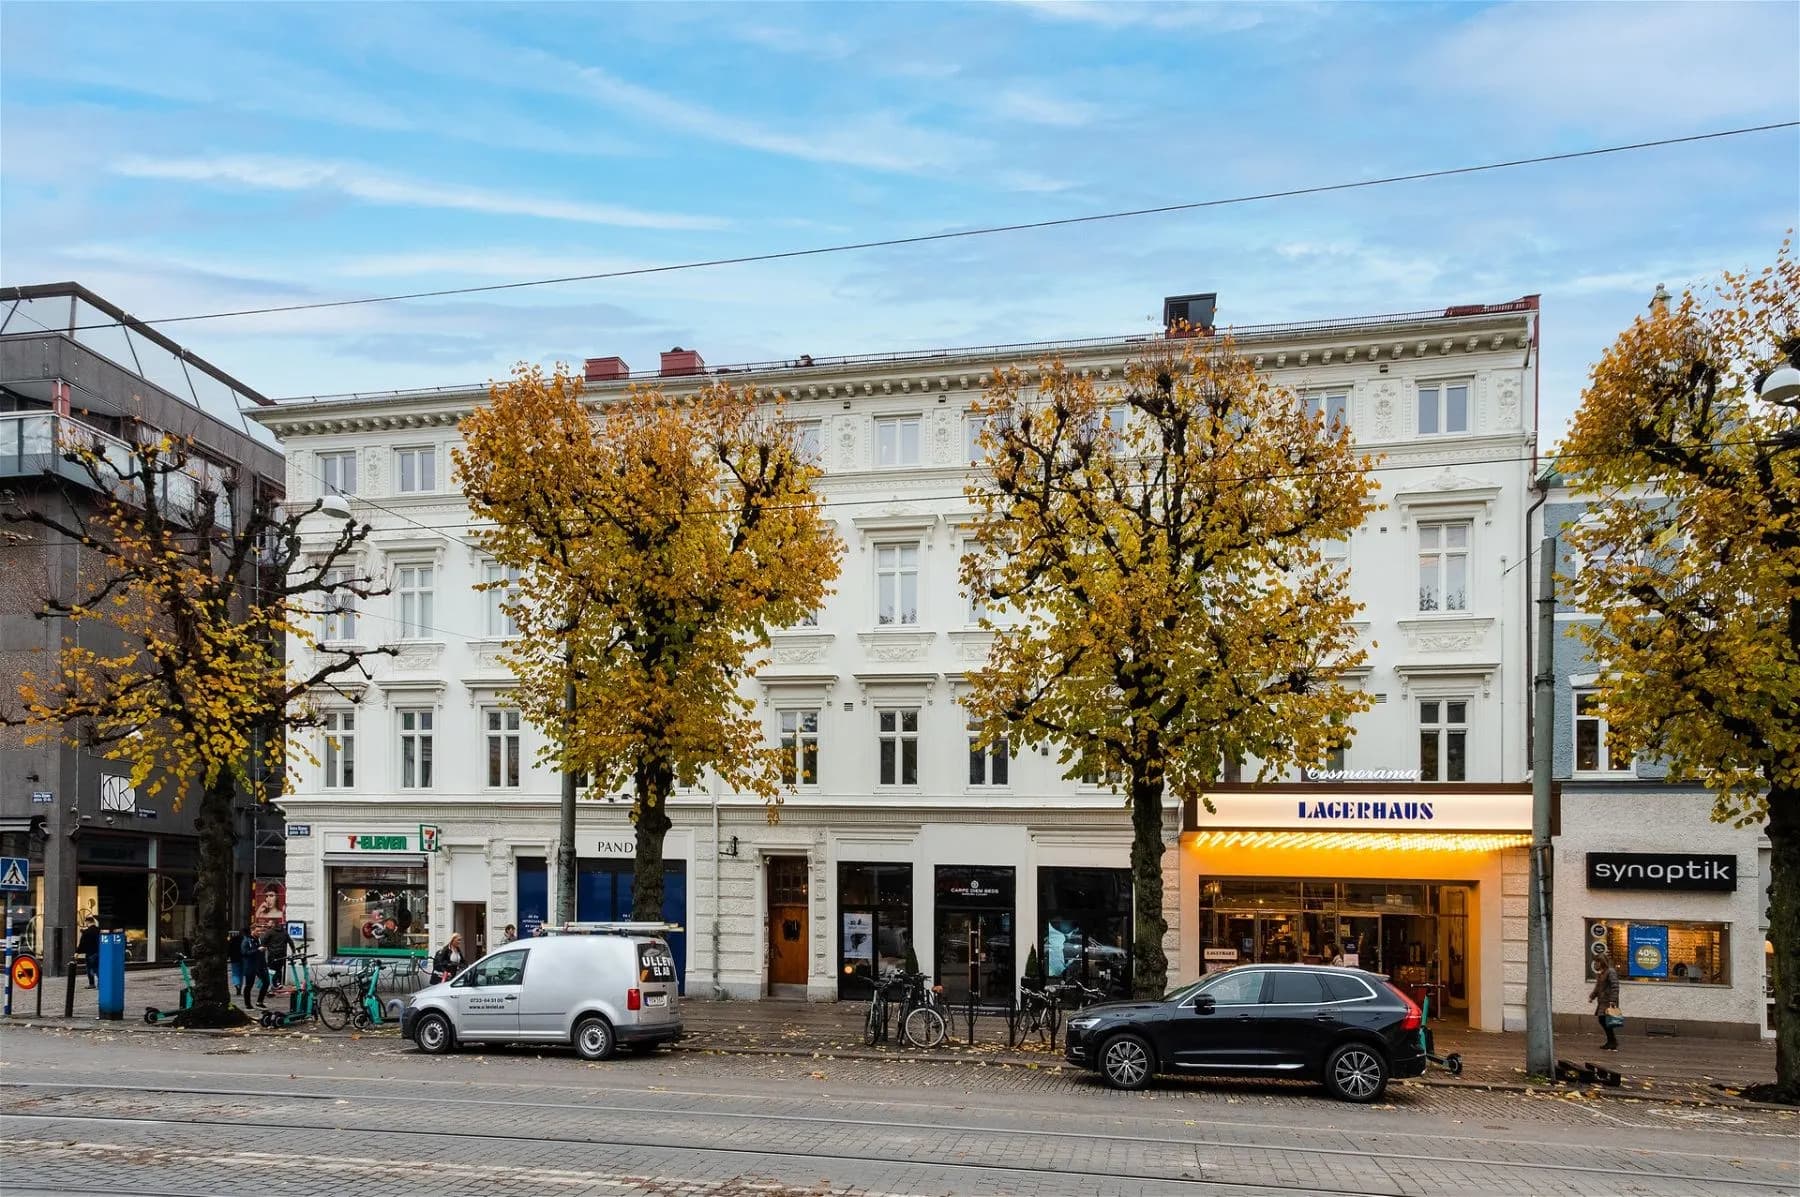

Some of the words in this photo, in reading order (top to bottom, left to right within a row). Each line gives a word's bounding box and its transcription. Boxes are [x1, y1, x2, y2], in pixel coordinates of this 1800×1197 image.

[1305, 763, 1423, 780] Cosmorama
[1298, 801, 1434, 820] LAGERHAUS
[598, 841, 634, 853] PAND
[1595, 860, 1730, 883] synoptik
